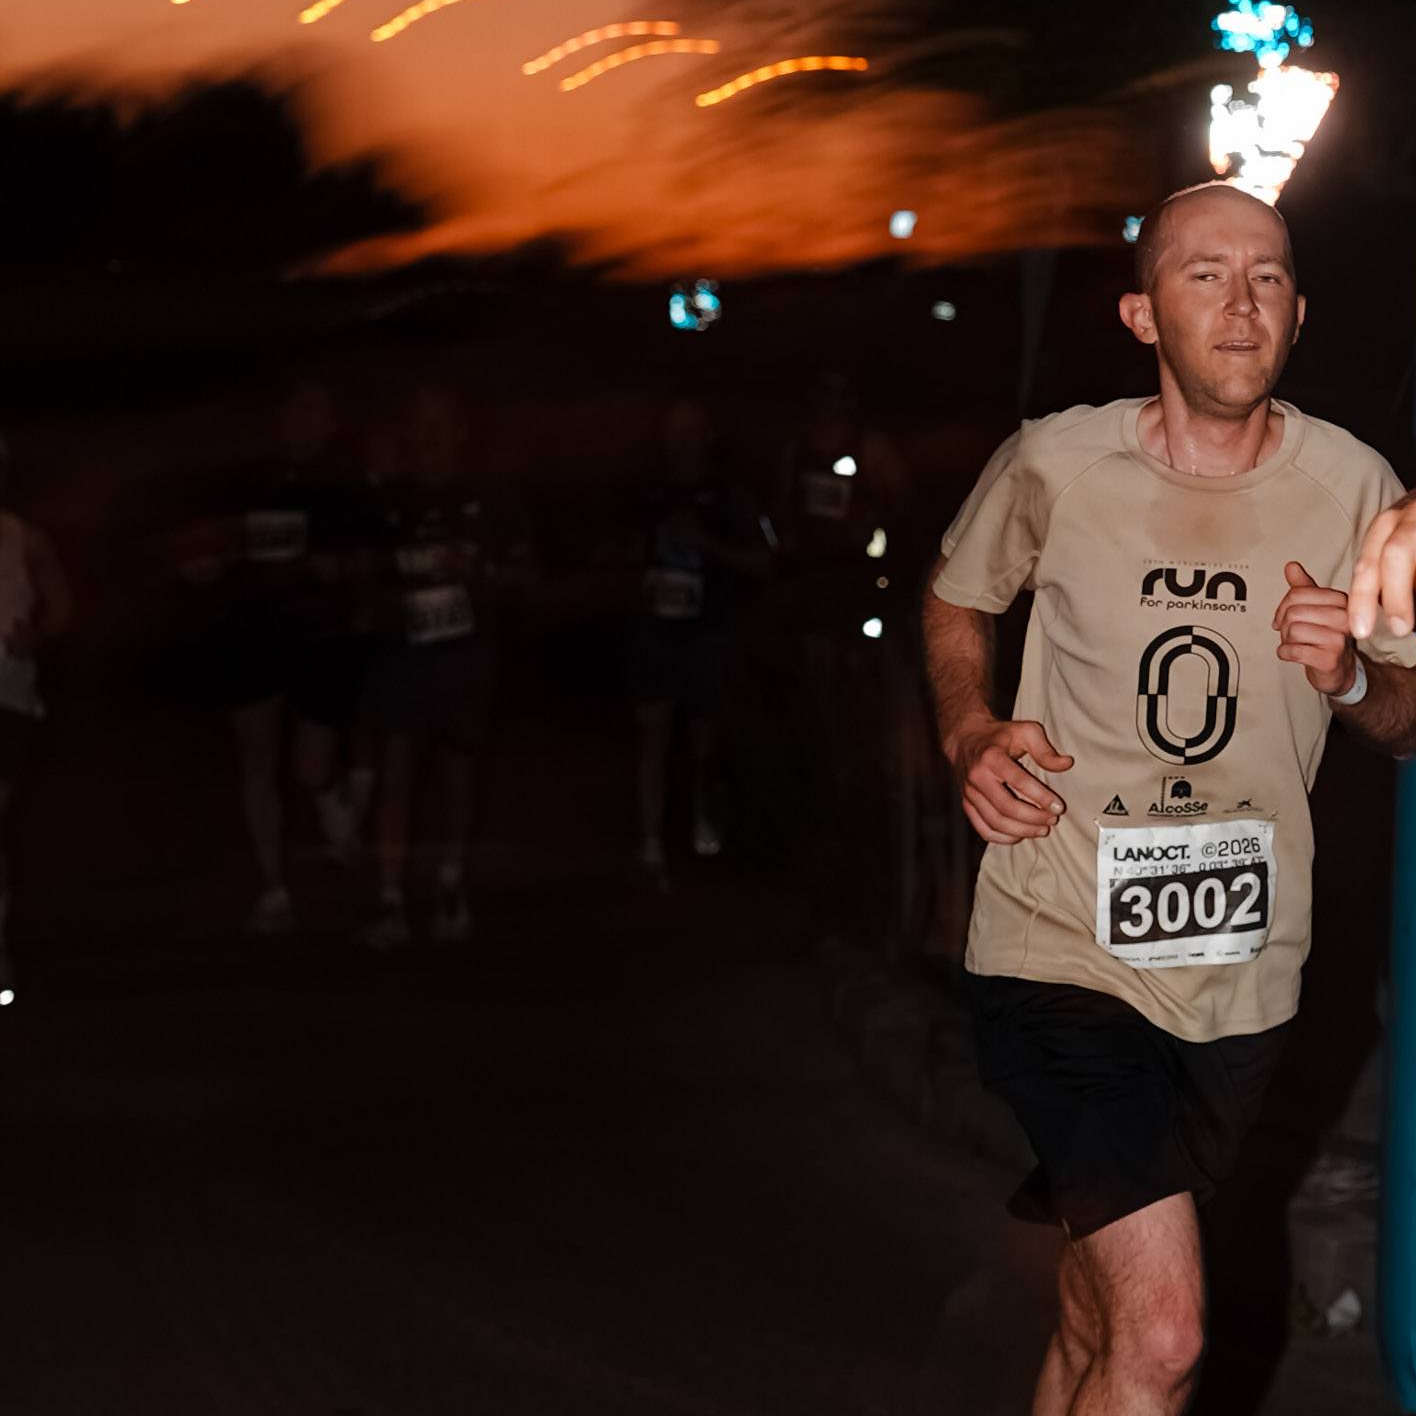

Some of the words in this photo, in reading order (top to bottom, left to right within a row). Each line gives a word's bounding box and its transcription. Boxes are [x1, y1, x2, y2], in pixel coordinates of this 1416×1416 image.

[1142, 567, 1247, 601] run
[1166, 599, 1247, 613] parkinson's
[1113, 844, 1191, 862] LANOCT.
[1119, 872, 1261, 938] 3002
